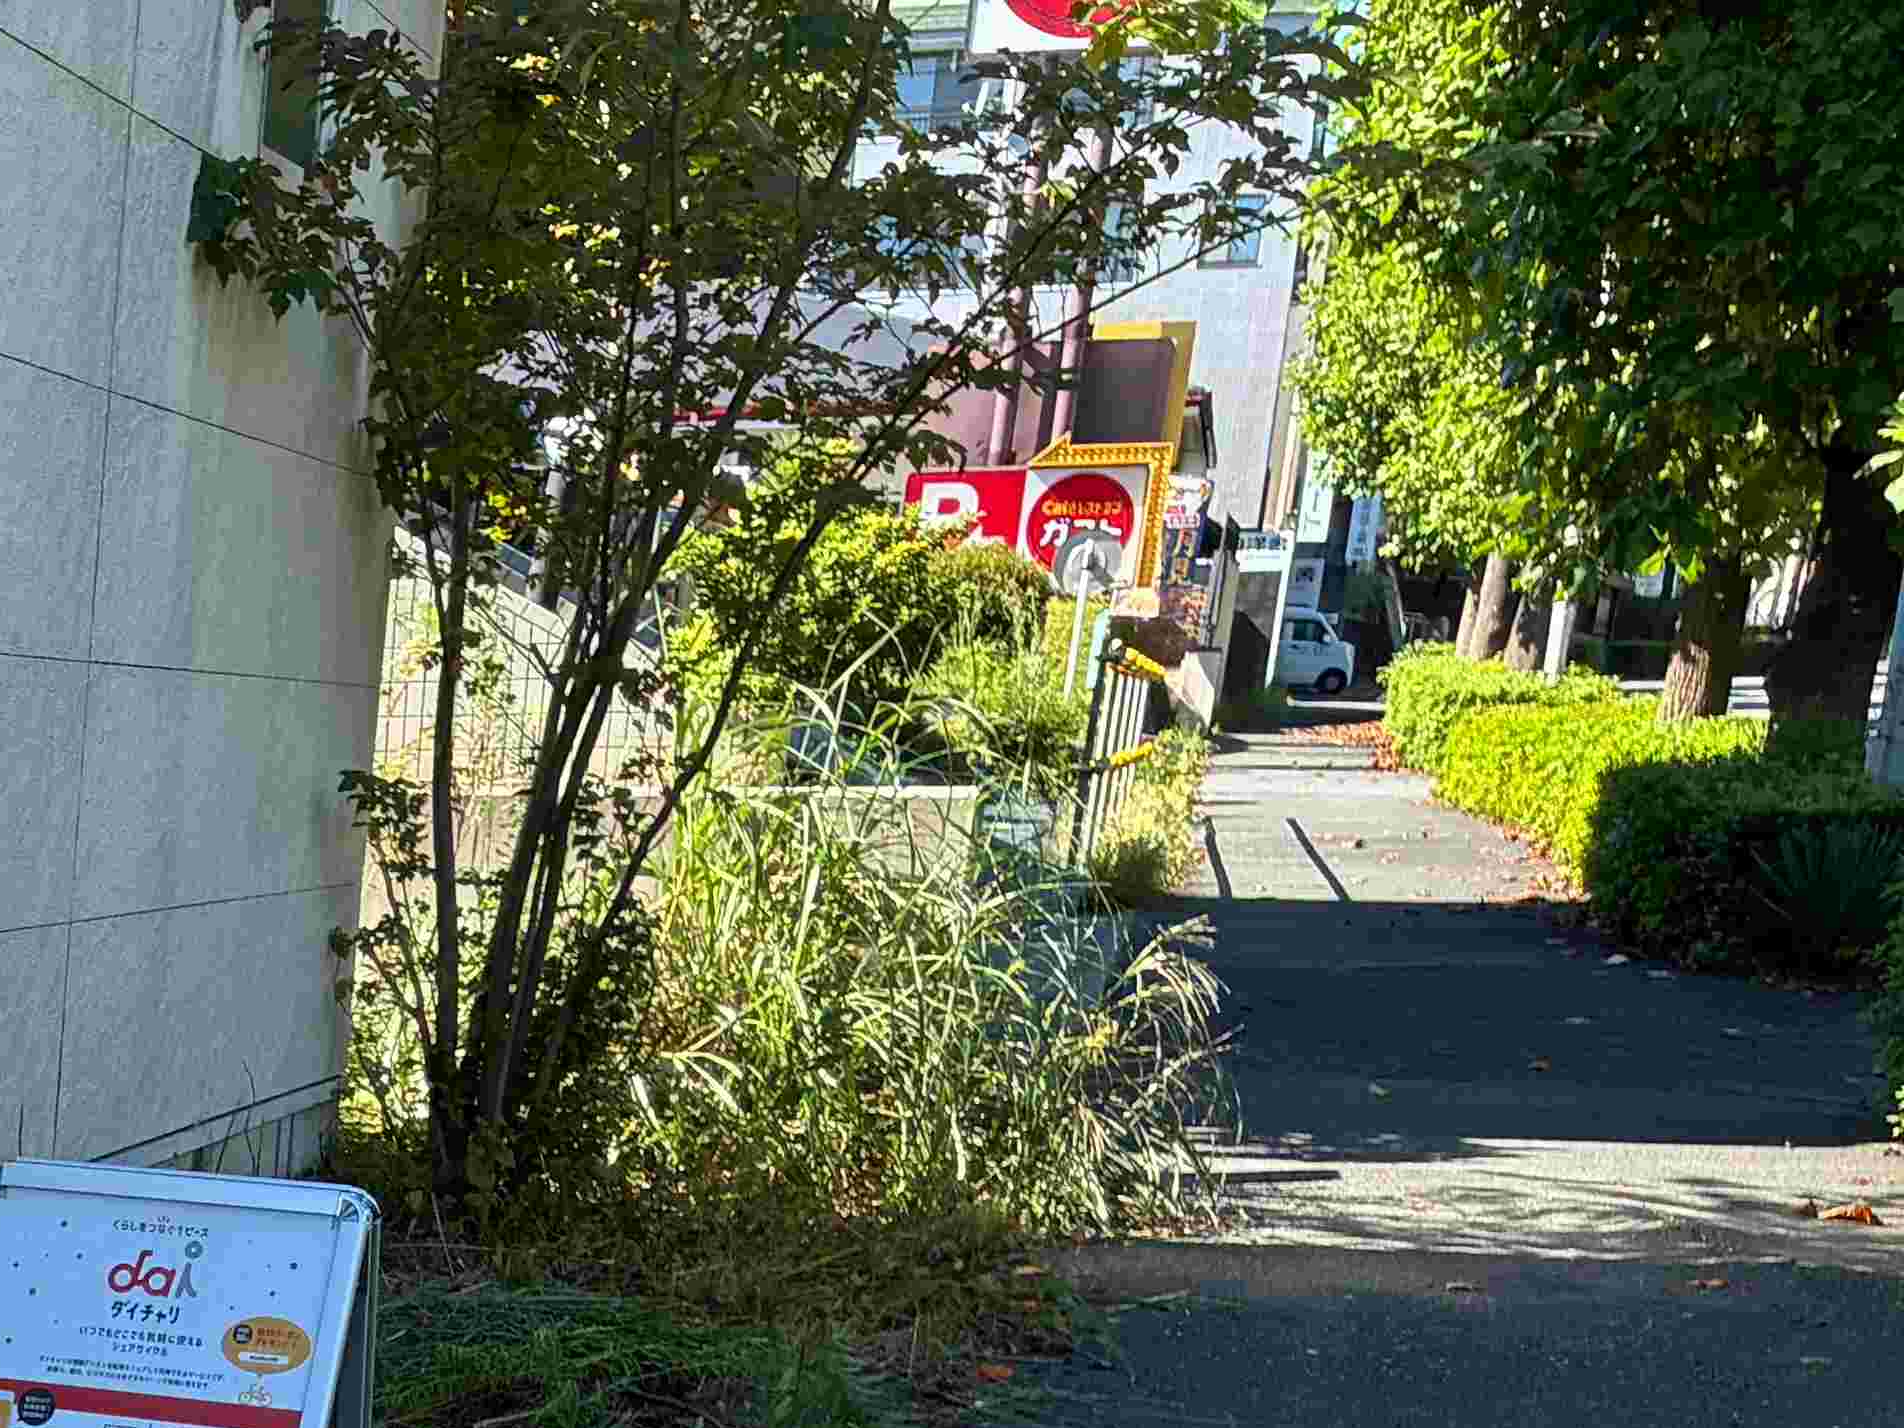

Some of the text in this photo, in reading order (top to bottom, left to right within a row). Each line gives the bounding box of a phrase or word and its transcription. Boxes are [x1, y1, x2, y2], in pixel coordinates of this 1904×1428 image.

[111, 1300, 180, 1325] ダイチャリ
